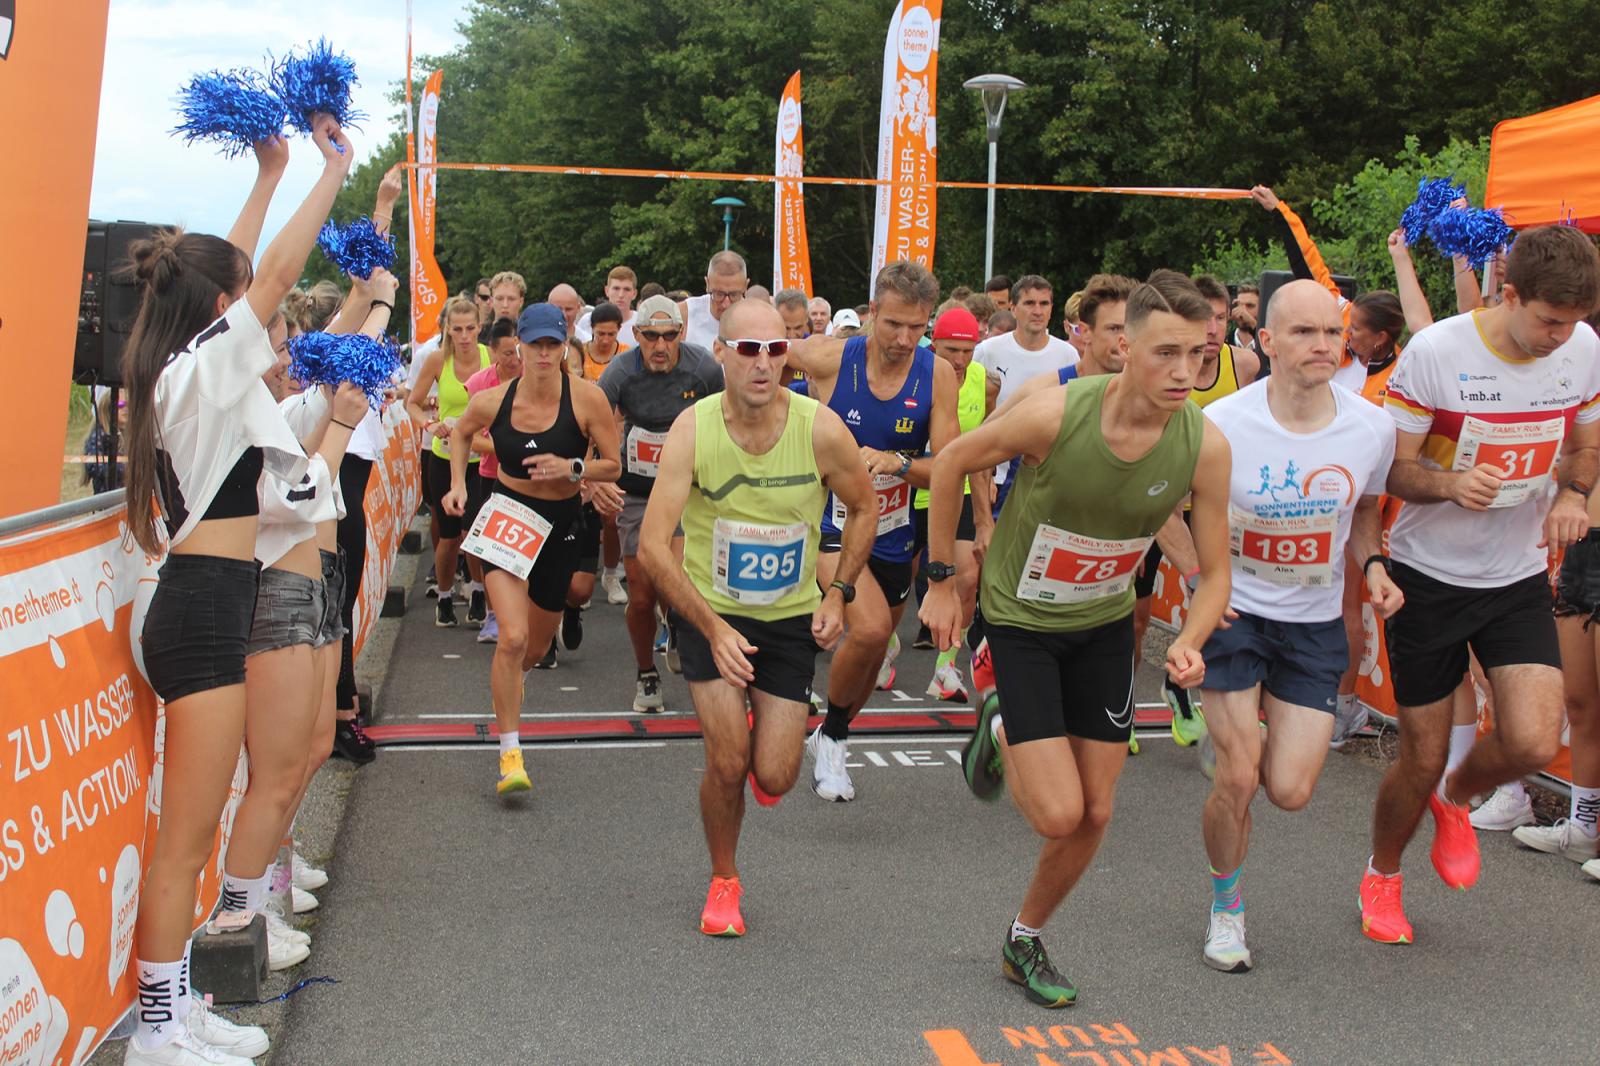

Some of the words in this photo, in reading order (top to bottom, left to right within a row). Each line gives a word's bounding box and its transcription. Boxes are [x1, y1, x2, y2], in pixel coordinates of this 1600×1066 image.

[904, 28, 929, 38] sonnen
[903, 40, 928, 52] therme
[789, 261, 798, 281] ZU
[1459, 390, 1502, 402] l-mb.at
[1491, 425, 1522, 433] FAMILY
[1523, 424, 1542, 432] RUN
[1500, 448, 1536, 479] 31
[503, 499, 523, 513] FAMILY
[523, 508, 537, 520] RUN
[1254, 498, 1338, 512] SONNENTHERME
[739, 526, 768, 536] FAMILY
[769, 527, 788, 537] RUN
[1254, 518, 1285, 528] FAMILY
[1287, 518, 1307, 527] RUN
[495, 519, 536, 551] 157
[1067, 535, 1103, 548] FAMILY
[1256, 538, 1319, 562] 193
[738, 550, 797, 580] 295
[1074, 558, 1118, 582] 78
[1274, 565, 1295, 574] Alex
[8, 718, 51, 783] ZU
[31, 804, 55, 855] &
[61, 745, 141, 841] ACTION!
[1, 975, 21, 999] meine
[0, 1021, 42, 1064] herme
